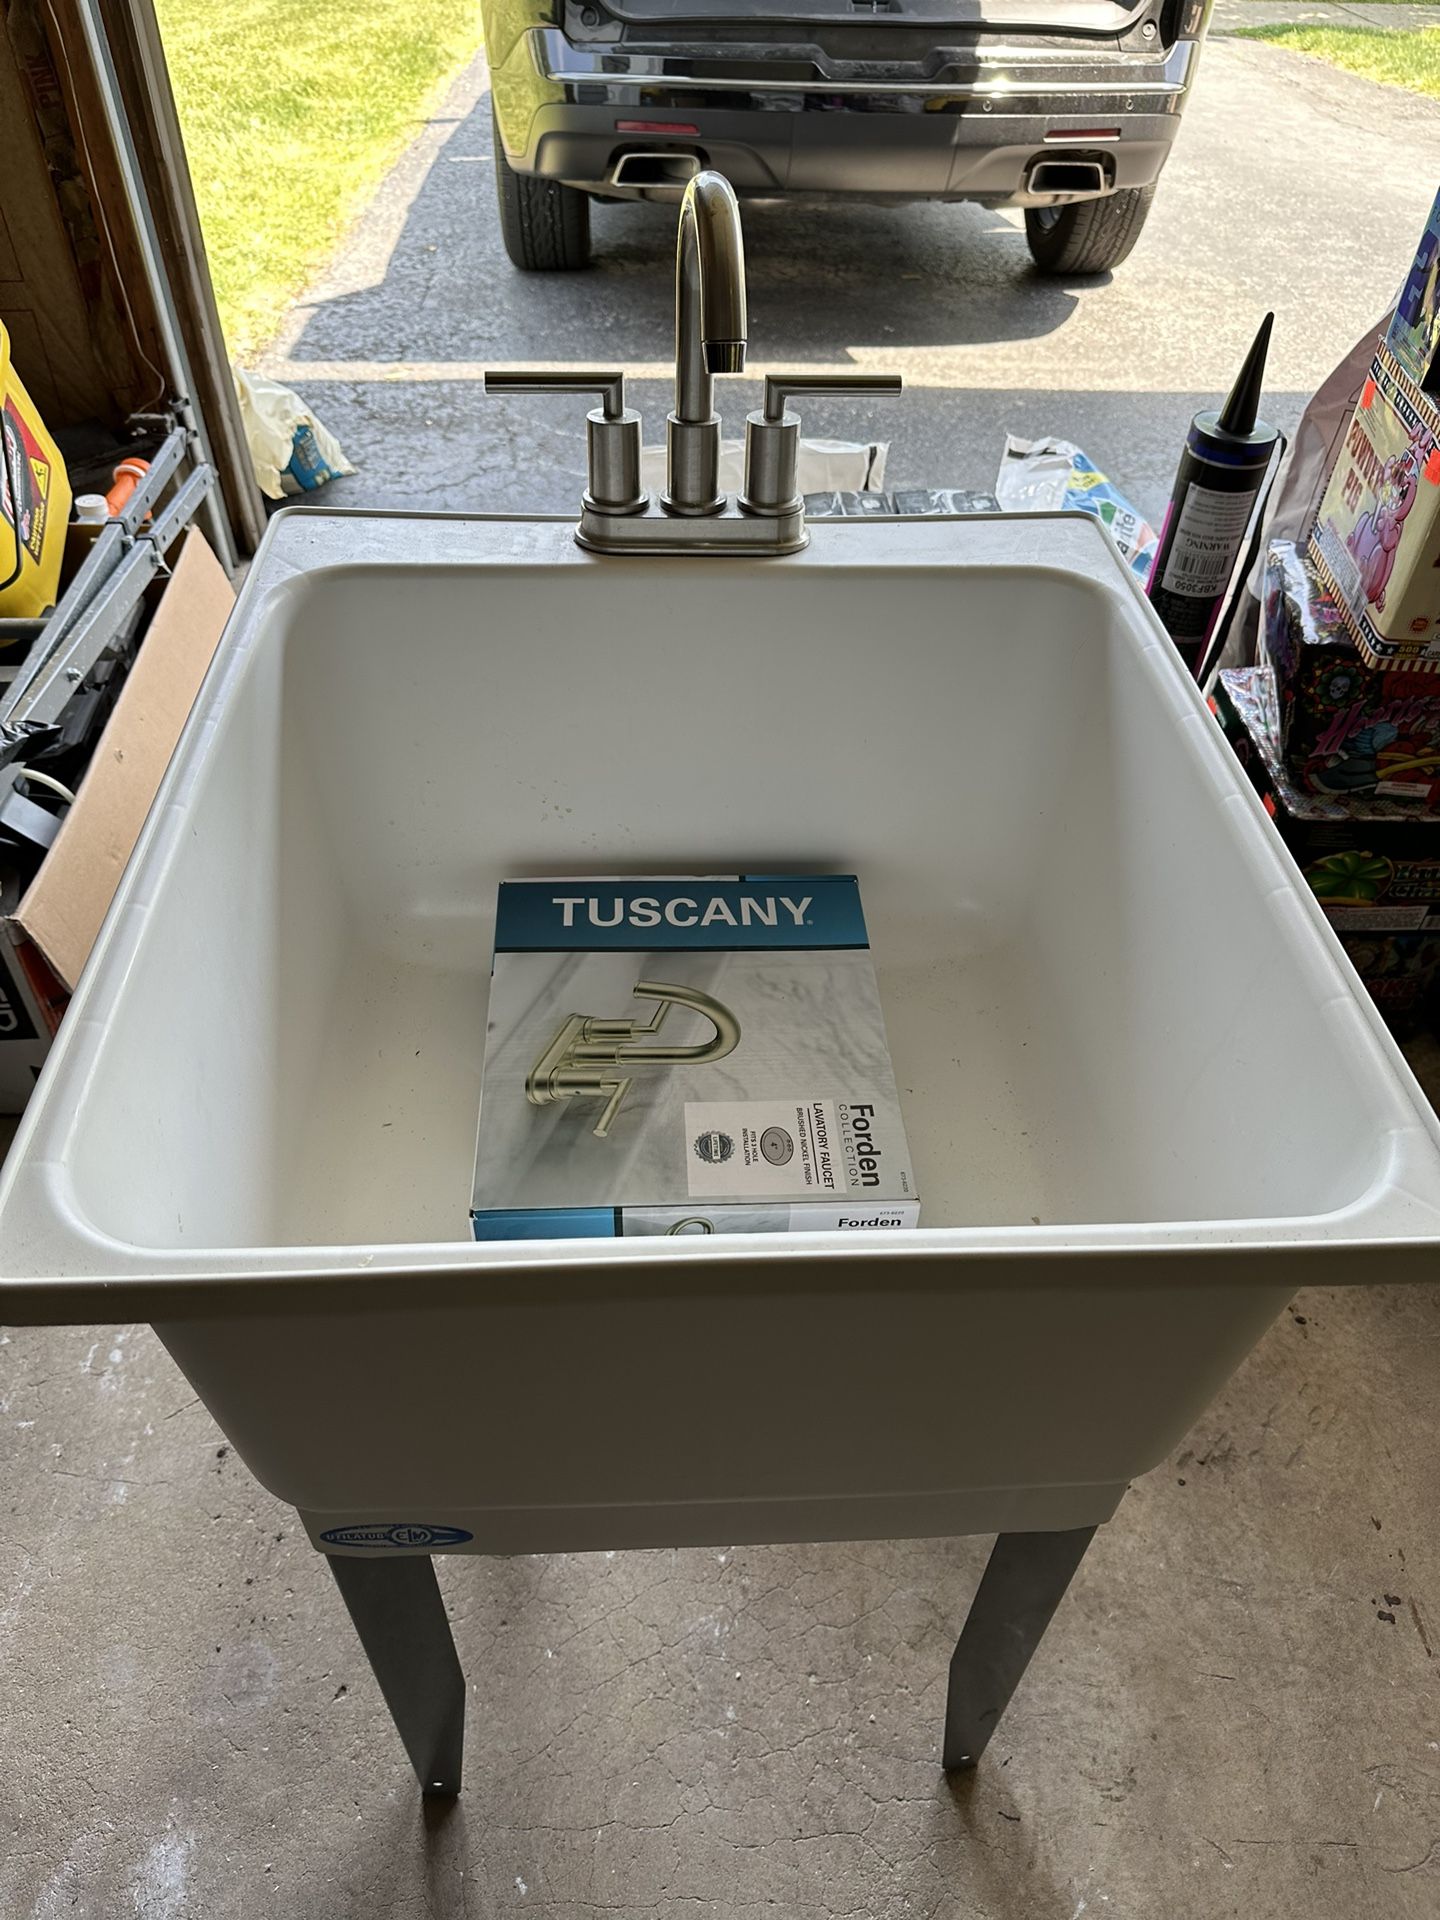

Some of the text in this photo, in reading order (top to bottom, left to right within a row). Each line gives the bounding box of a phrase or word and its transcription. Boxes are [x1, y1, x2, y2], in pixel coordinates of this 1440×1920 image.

[1341, 468, 1363, 514] PIG
[1185, 538, 1230, 551] WARNING
[1175, 581, 1217, 594] KBF3050
[552, 896, 812, 927] TUSCANY
[742, 1127, 751, 1166] INSTALLATION
[796, 1107, 813, 1185] BRUSHED NICKEL FINISH
[813, 1102, 835, 1189] LAVATORY FAUCET
[838, 1103, 860, 1187] COLLECTION
[850, 1104, 881, 1187] Forden
[838, 1218, 902, 1228] Forden
